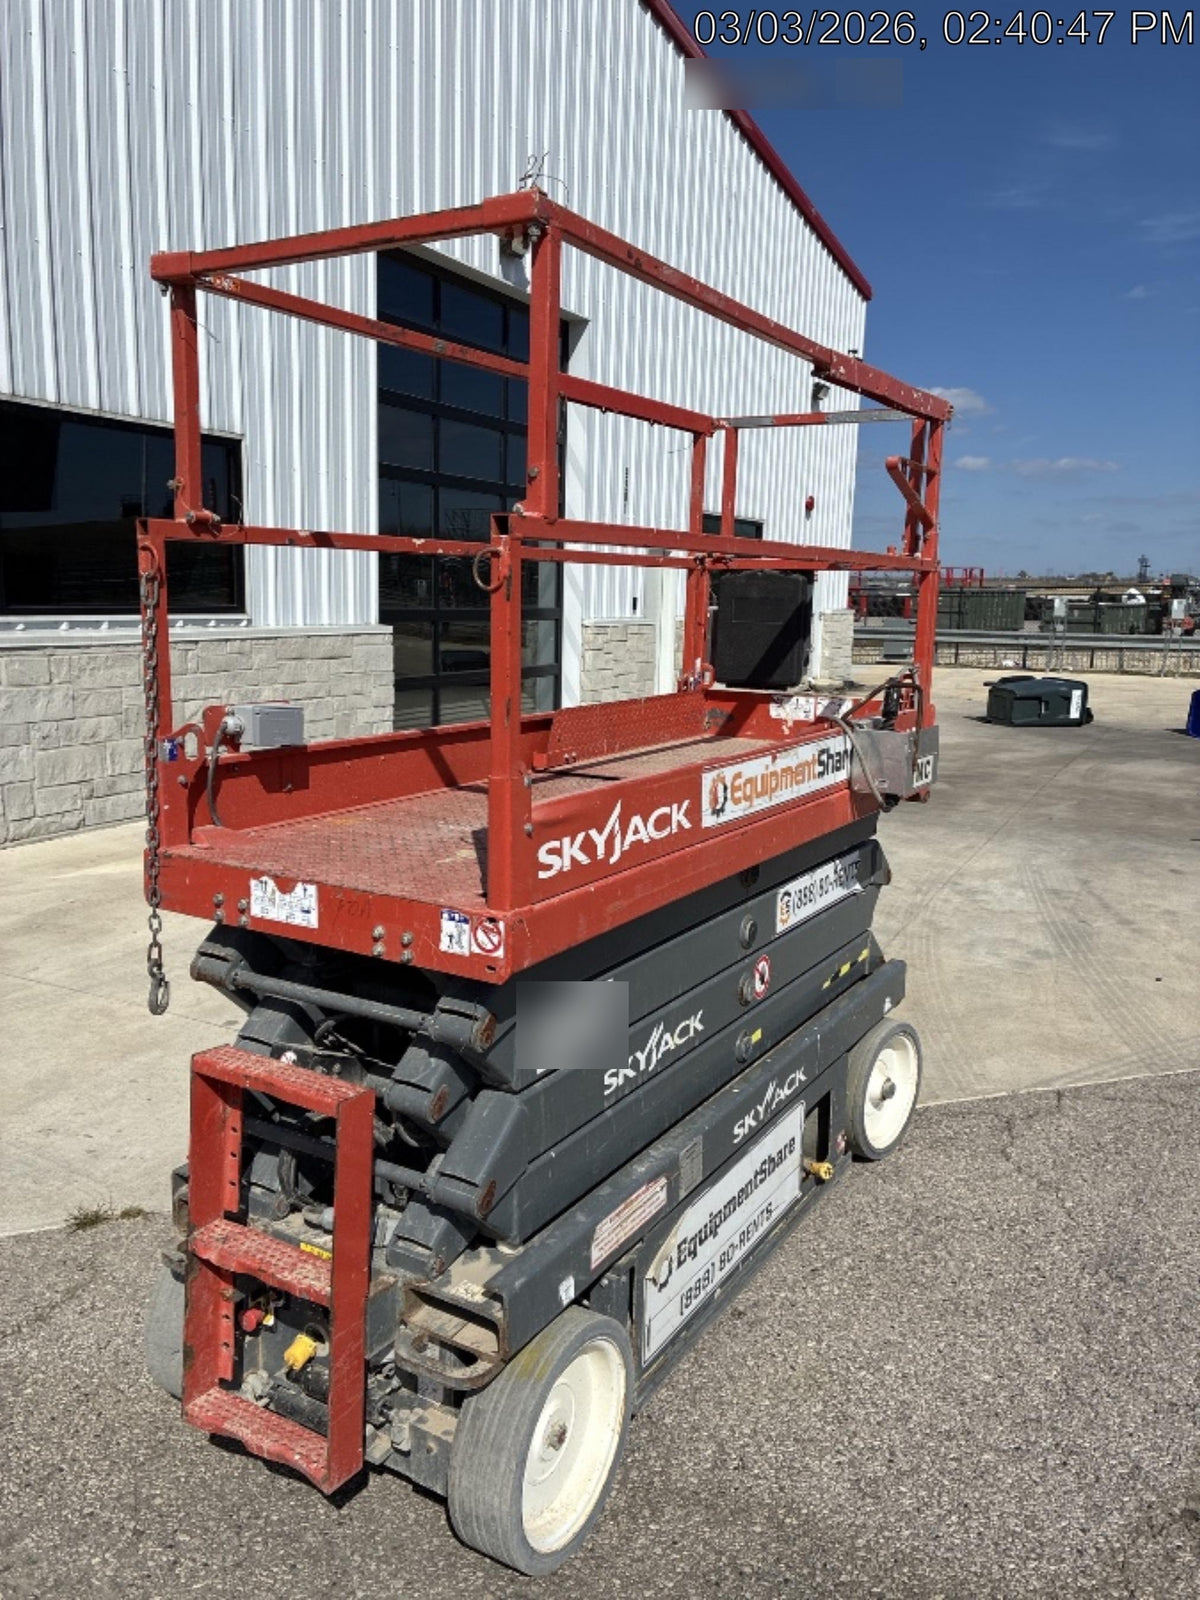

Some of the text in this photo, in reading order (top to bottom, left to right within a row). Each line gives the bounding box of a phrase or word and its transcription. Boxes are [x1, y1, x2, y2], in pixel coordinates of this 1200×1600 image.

[537, 800, 691, 879] SKYJACK
[733, 1066, 807, 1144] SKYJACK
[677, 1136, 796, 1269] EquipmentShare
[680, 1262, 715, 1316] (888)
